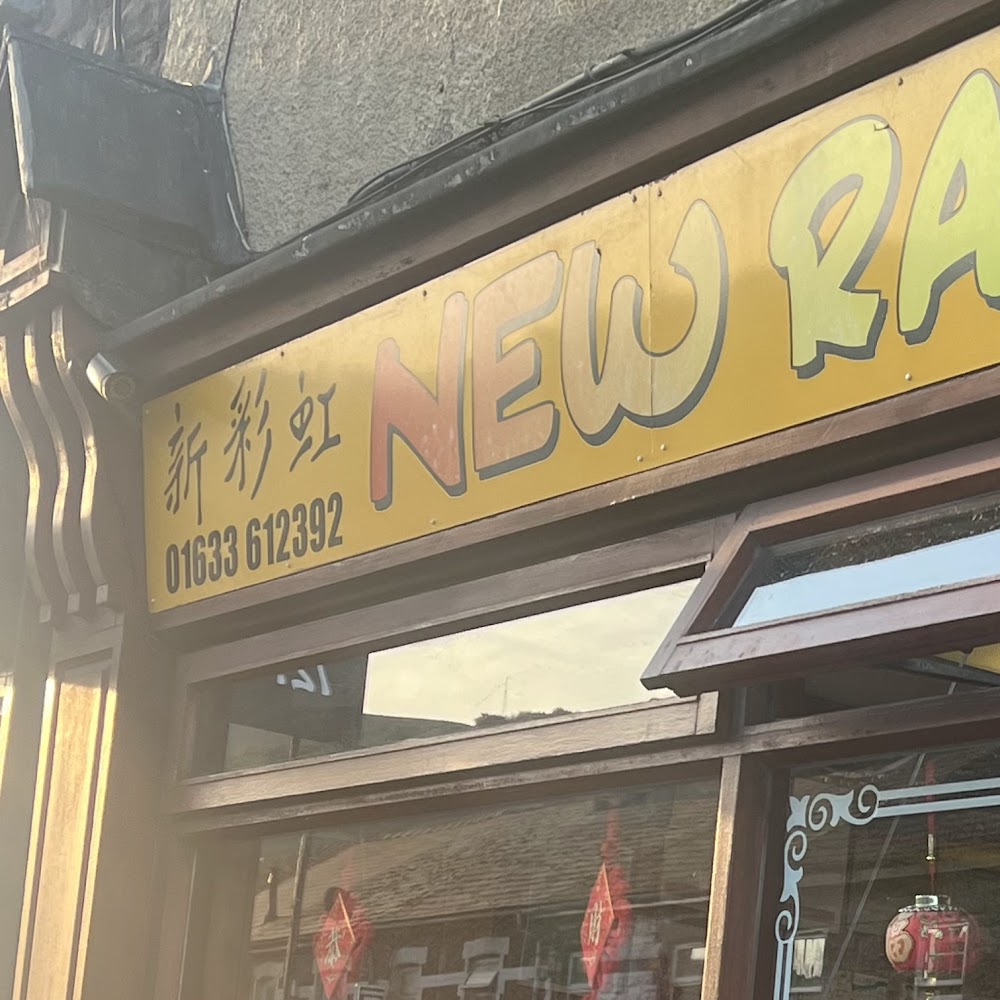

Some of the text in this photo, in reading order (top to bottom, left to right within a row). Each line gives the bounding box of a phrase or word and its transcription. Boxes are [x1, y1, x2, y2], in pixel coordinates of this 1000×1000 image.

[369, 198, 730, 512] NEW
[164, 367, 342, 526] 新彩虹
[164, 490, 344, 595] 01633 612392
